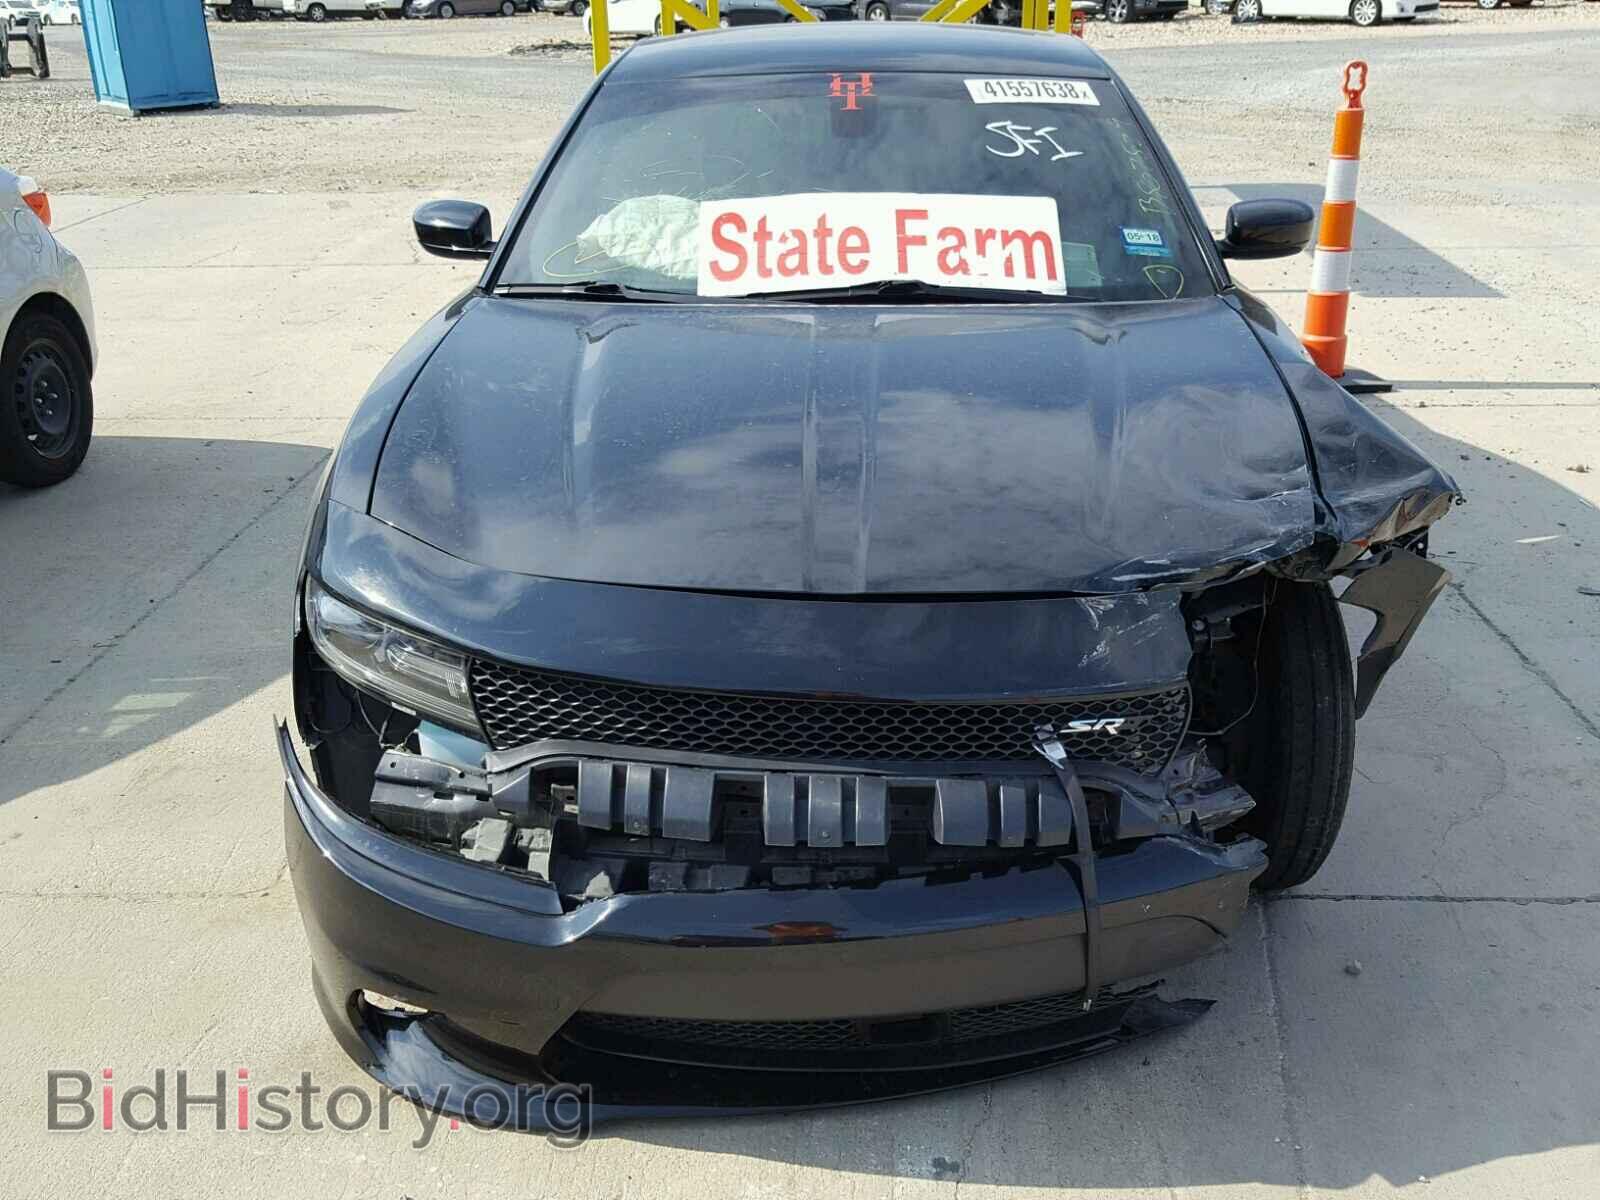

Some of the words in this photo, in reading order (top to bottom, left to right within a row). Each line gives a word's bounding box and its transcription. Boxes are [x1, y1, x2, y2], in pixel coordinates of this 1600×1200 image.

[984, 81, 1080, 99] 41557638
[709, 211, 871, 281] State
[895, 208, 1058, 281] Farm
